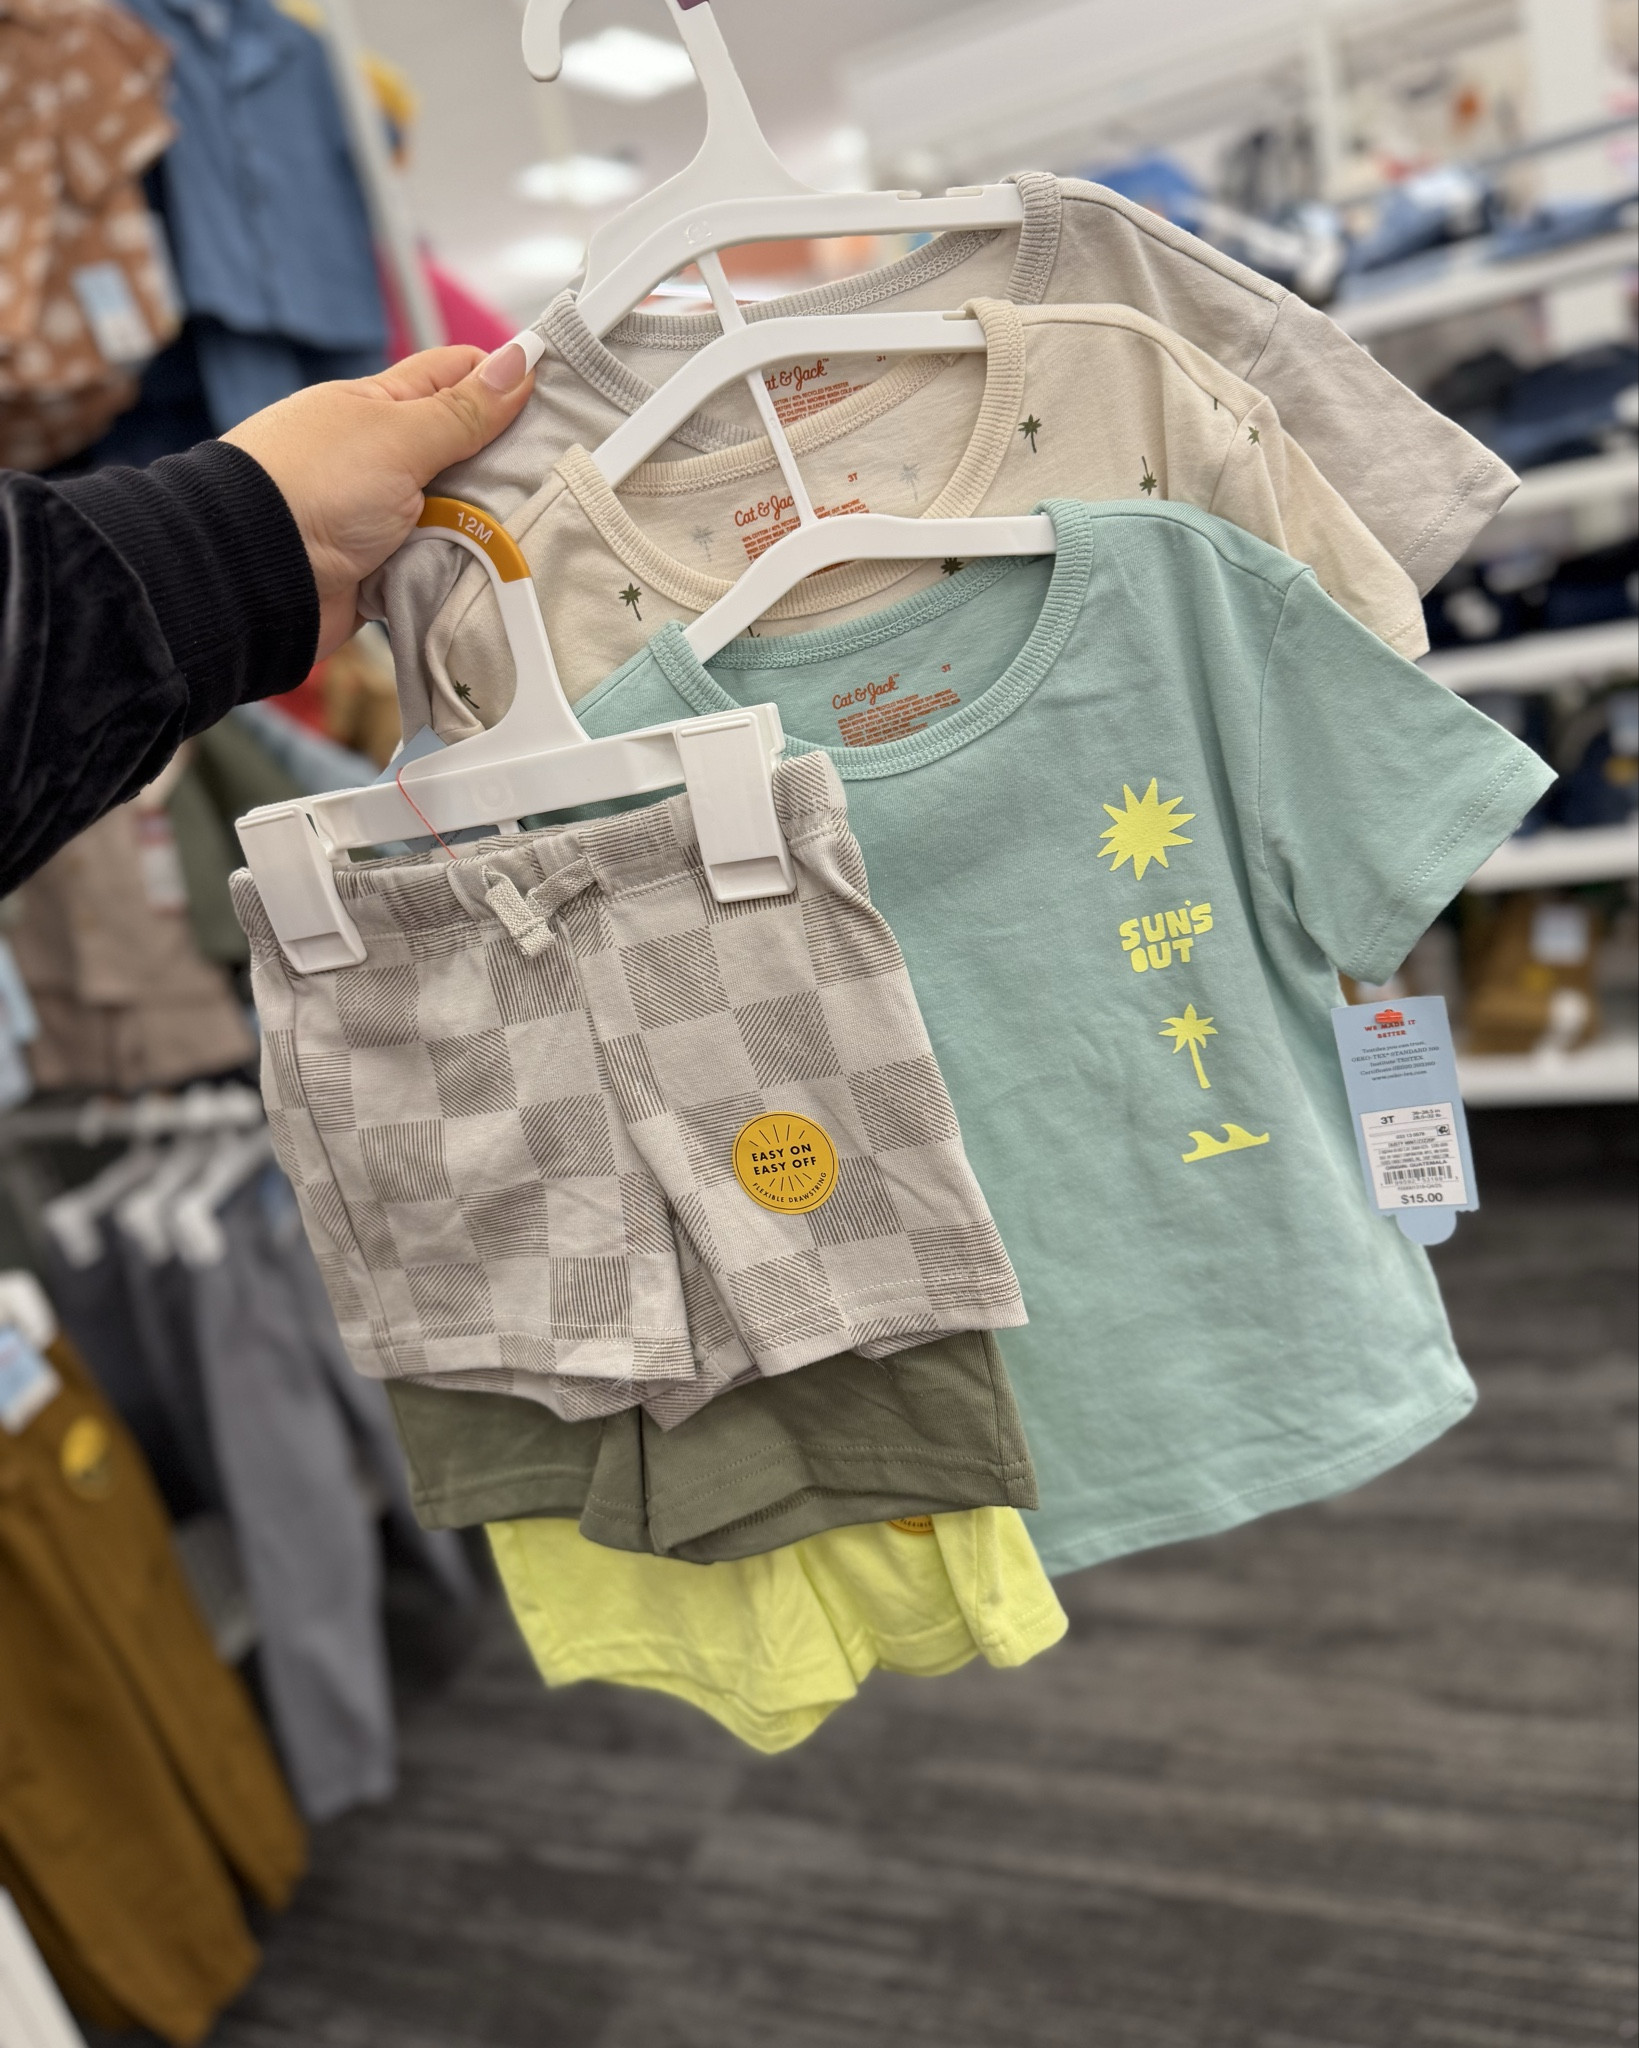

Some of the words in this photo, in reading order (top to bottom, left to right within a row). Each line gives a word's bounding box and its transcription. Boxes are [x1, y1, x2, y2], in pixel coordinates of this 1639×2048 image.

[765, 376, 778, 391] at
[780, 372, 792, 386] &
[848, 472, 858, 483] 3T
[735, 506, 758, 527] Cat
[758, 502, 770, 517] &
[771, 495, 796, 521] Jac
[458, 512, 494, 544] 12M
[832, 693, 855, 710] Cat
[855, 688, 867, 702] &
[1130, 937, 1194, 973] OUT
[1377, 1030, 1407, 1039] BETTER
[1381, 1021, 1405, 1029] MADE
[1381, 1116, 1395, 1125] 3T
[752, 1149, 784, 1162] EASY
[790, 1144, 812, 1155] ON
[754, 1162, 786, 1176] EASY
[792, 1157, 817, 1169] OFF
[753, 1183, 785, 1203] FLEXIBLE
[789, 1172, 827, 1203] DRAWSTRING
[1401, 1193, 1443, 1205] $15.00
